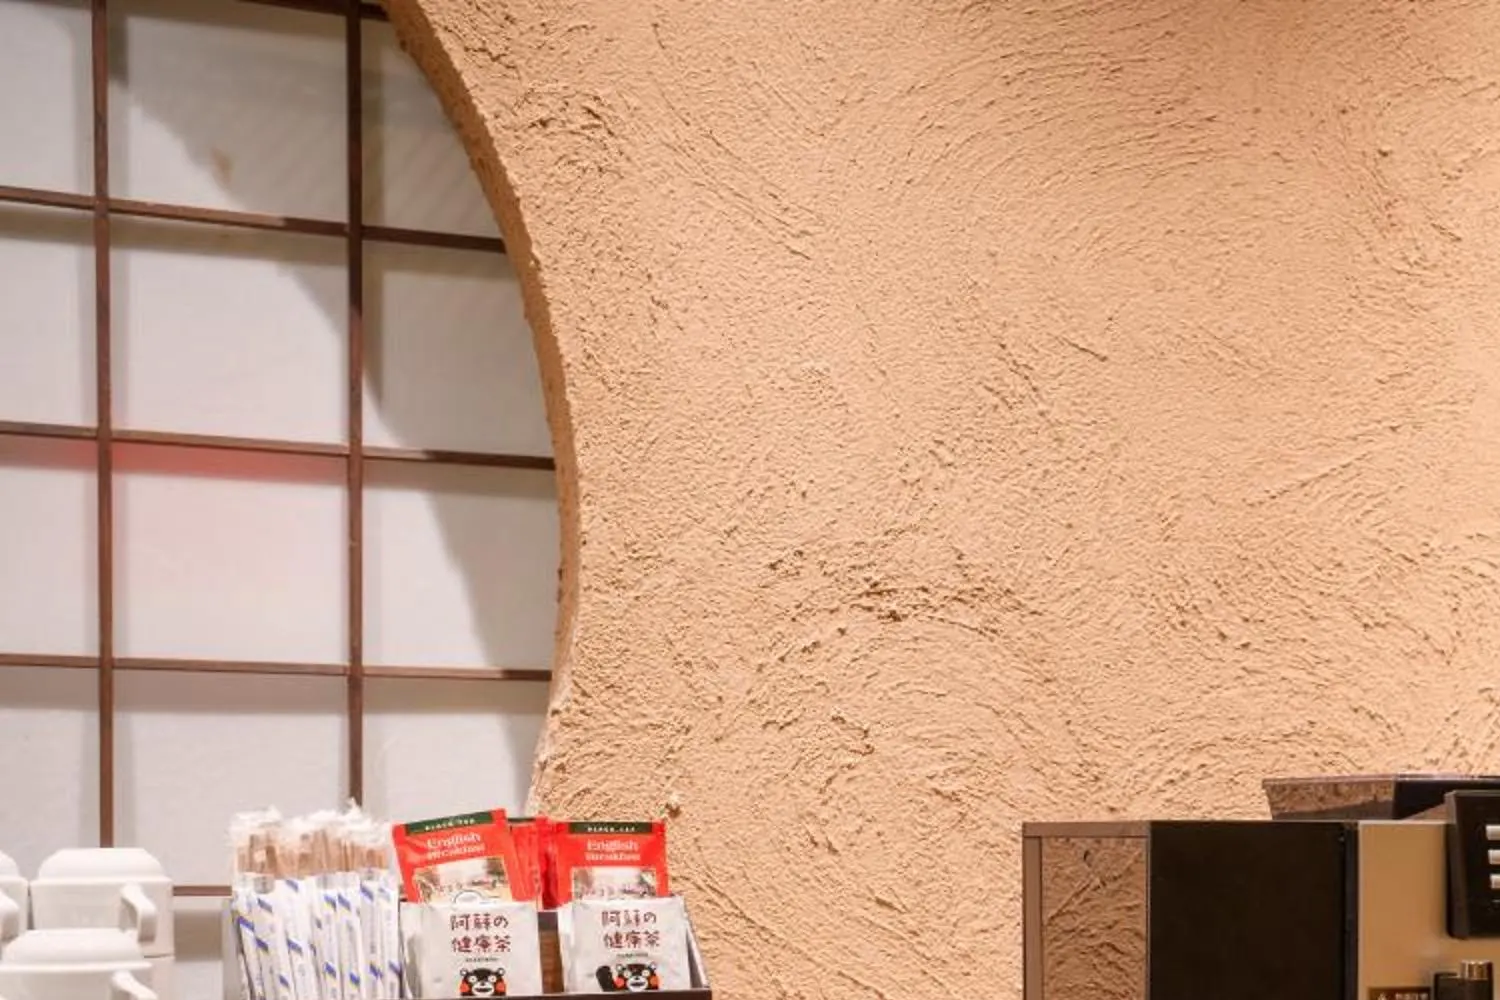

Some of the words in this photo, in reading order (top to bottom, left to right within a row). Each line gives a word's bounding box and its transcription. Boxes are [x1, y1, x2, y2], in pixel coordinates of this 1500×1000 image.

[427, 832, 482, 850] English
[587, 840, 639, 852] English
[449, 912, 510, 931] 阿蘇の
[451, 934, 511, 953] 健康茶
[603, 930, 660, 949] 健康茶
